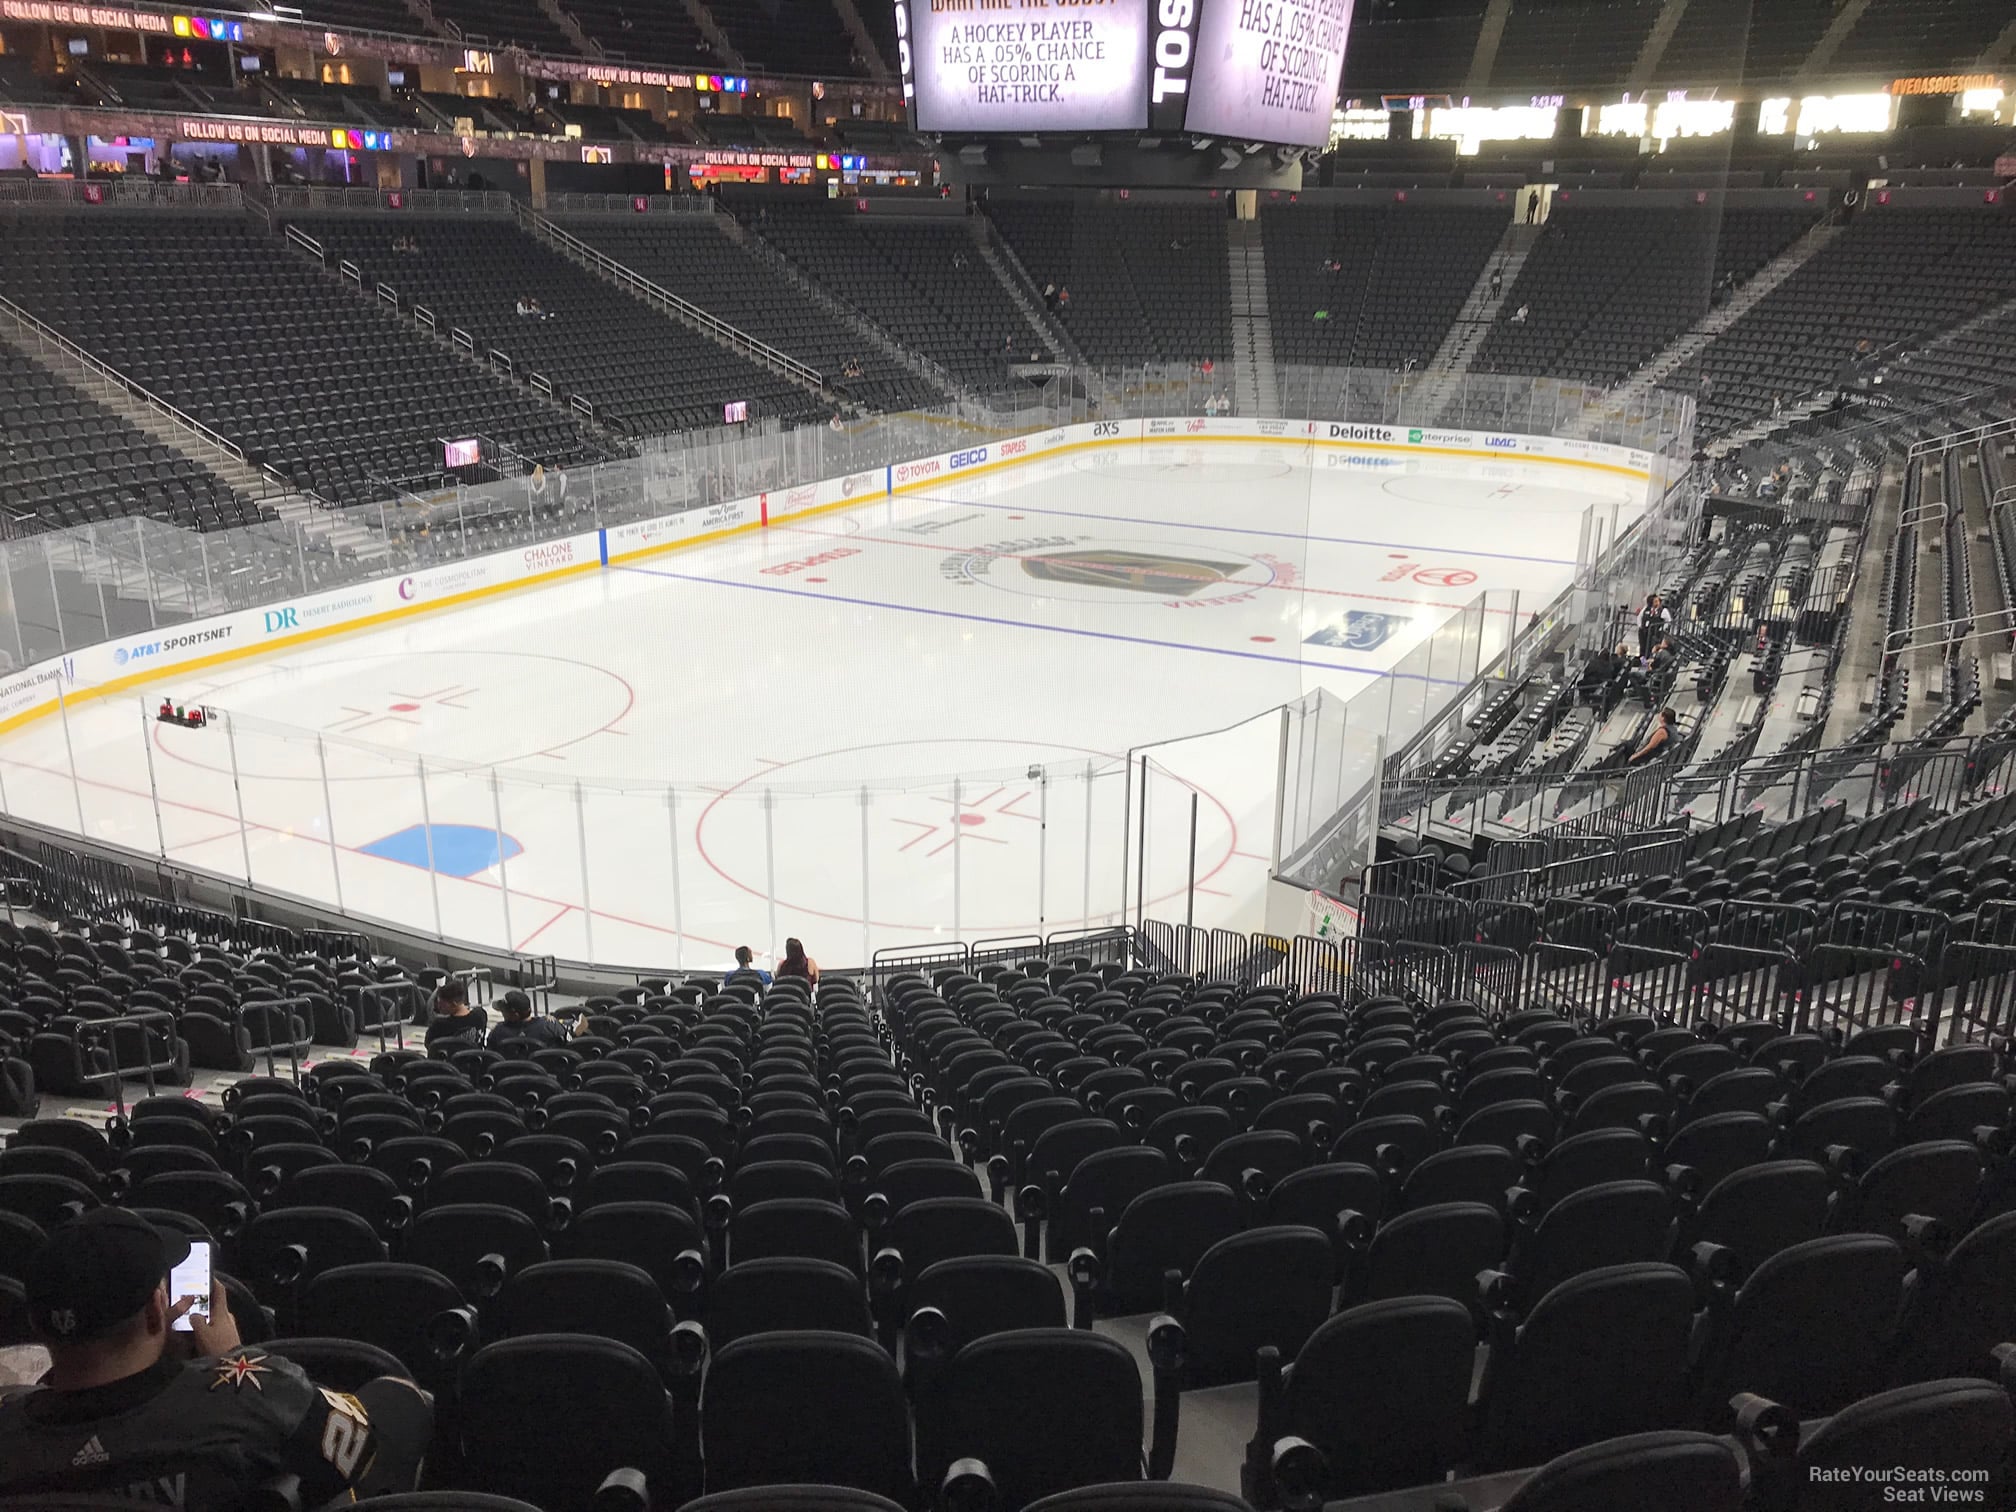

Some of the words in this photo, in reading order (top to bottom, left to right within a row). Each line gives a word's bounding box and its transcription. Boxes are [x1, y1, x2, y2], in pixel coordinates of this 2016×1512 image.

[3, 1, 50, 20] FOLLOW
[54, 6, 70, 22] US
[73, 8, 90, 24] ON
[92, 10, 132, 28] SOCIAL
[134, 14, 168, 32] MEDIA
[1240, 0, 1272, 34] HAS
[1272, 6, 1283, 38] A
[951, 26, 961, 44] A
[965, 22, 1026, 44] HOCKEY
[1031, 20, 1094, 42] PLAYER
[943, 46, 972, 64] HAS
[975, 45, 986, 64] A
[990, 43, 1032, 64] .05%
[1036, 41, 1106, 62] CHANCE
[1260, 40, 1280, 72] OF
[1280, 43, 1322, 82] SCORING
[587, 67, 618, 82] FOLLOW
[618, 70, 630, 82] US
[630, 71, 642, 84] ON
[642, 72, 668, 86] SOCIAL
[669, 74, 692, 88] MEDIA
[968, 66, 987, 84] OF
[990, 64, 1060, 84] SCORING
[1064, 64, 1076, 81] A
[978, 83, 1065, 104] HAT-TRICK.
[183, 122, 225, 140] FOLLOW
[228, 126, 242, 141] US
[244, 127, 260, 142] ON
[262, 128, 296, 144] SOCIAL
[298, 130, 328, 146] MEDIA
[704, 152, 736, 165] FOLLOW
[737, 153, 748, 165] US
[749, 154, 760, 166] ON
[762, 154, 788, 167] SOCIAL
[790, 155, 812, 168] MEDIA
[1093, 422, 1120, 438] axs
[950, 448, 988, 470] GEICO
[1000, 440, 1027, 457] STAPLES
[910, 460, 940, 477] TOYOTA
[702, 514, 728, 528] AMERICA
[728, 511, 744, 522] FIRST
[524, 542, 572, 562] CHALONE
[526, 553, 574, 571] VINEYARD
[302, 604, 330, 618] DESERT
[332, 594, 374, 612] RADIOLOGY
[264, 607, 300, 633] DR
[131, 642, 162, 660] AT&T
[164, 626, 233, 652] SPORTSNET
[72, 1452, 110, 1466] adidas
